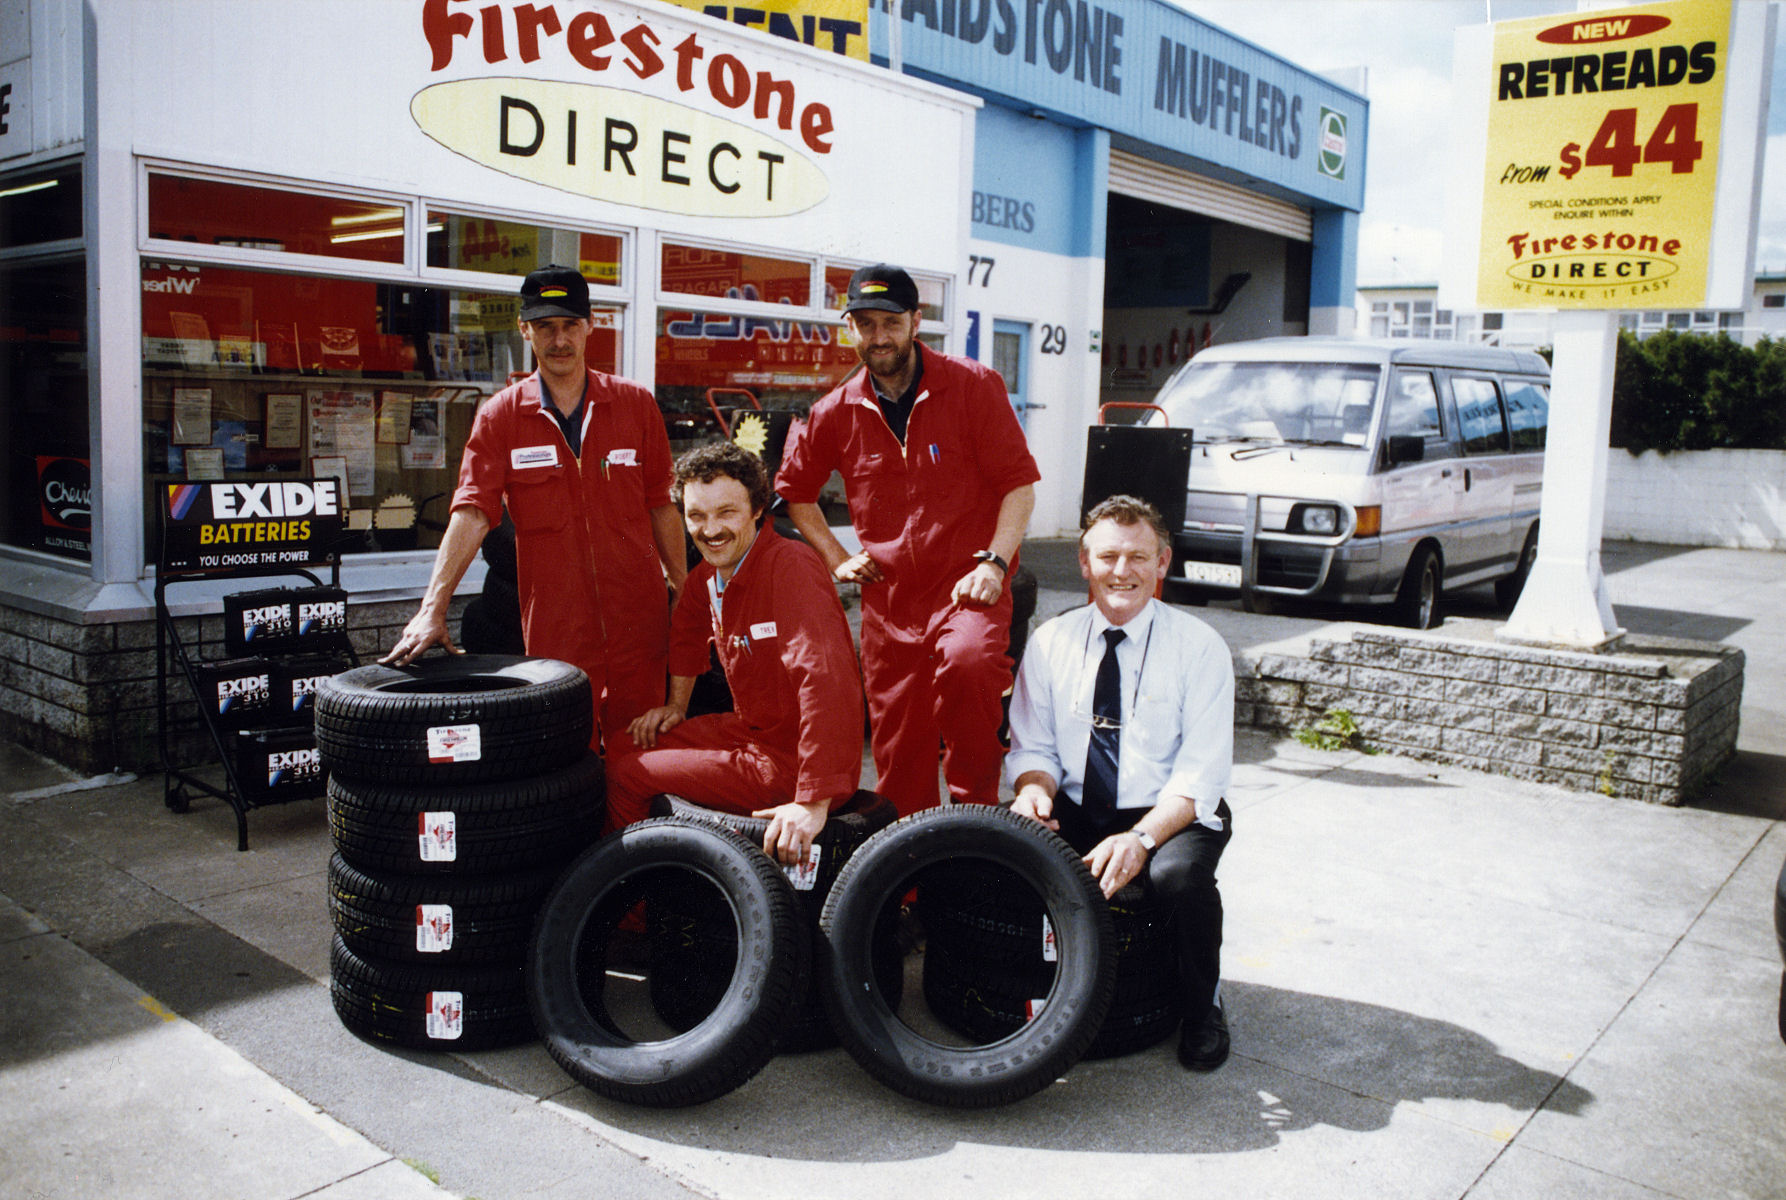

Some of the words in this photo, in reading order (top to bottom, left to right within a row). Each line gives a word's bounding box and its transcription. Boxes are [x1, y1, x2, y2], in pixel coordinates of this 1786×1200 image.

[703, 5, 862, 56] NT
[1572, 19, 1632, 41] NEW
[422, 0, 835, 154] Firestone
[1497, 41, 1717, 102] RETREADS
[1154, 35, 1304, 161] MUFFLERS
[499, 95, 785, 201] DIRECT
[1500, 163, 1551, 184] from
[1558, 102, 1704, 181] $44
[1529, 200, 1563, 209] SPECIAL
[1567, 196, 1629, 207] CONDITIONS
[1632, 195, 1662, 205] APPLY
[1553, 209, 1595, 220] ENQUIRE
[1598, 208, 1634, 218] WITHIN
[1506, 231, 1682, 260] Firestone
[1531, 261, 1652, 279] DIRECT
[1512, 281, 1532, 293] WE
[1544, 288, 1586, 300] MAKE
[1603, 288, 1617, 299] IT
[1631, 279, 1671, 296] EASY
[1040, 323, 1067, 356] 29
[210, 480, 338, 520] EXIDE
[200, 520, 312, 545] BATTERIES
[200, 555, 219, 567] YOU
[221, 553, 258, 566] CHOOSE
[261, 552, 277, 563] THE
[279, 550, 310, 562] POWER
[243, 604, 291, 623] EXIDE
[299, 601, 345, 617] EXIDE
[267, 620, 292, 630] 310
[320, 617, 345, 626] 310
[218, 674, 269, 695] EXIDE
[243, 691, 270, 702] 310
[268, 748, 321, 768] EXIDE
[294, 765, 321, 776] 310
